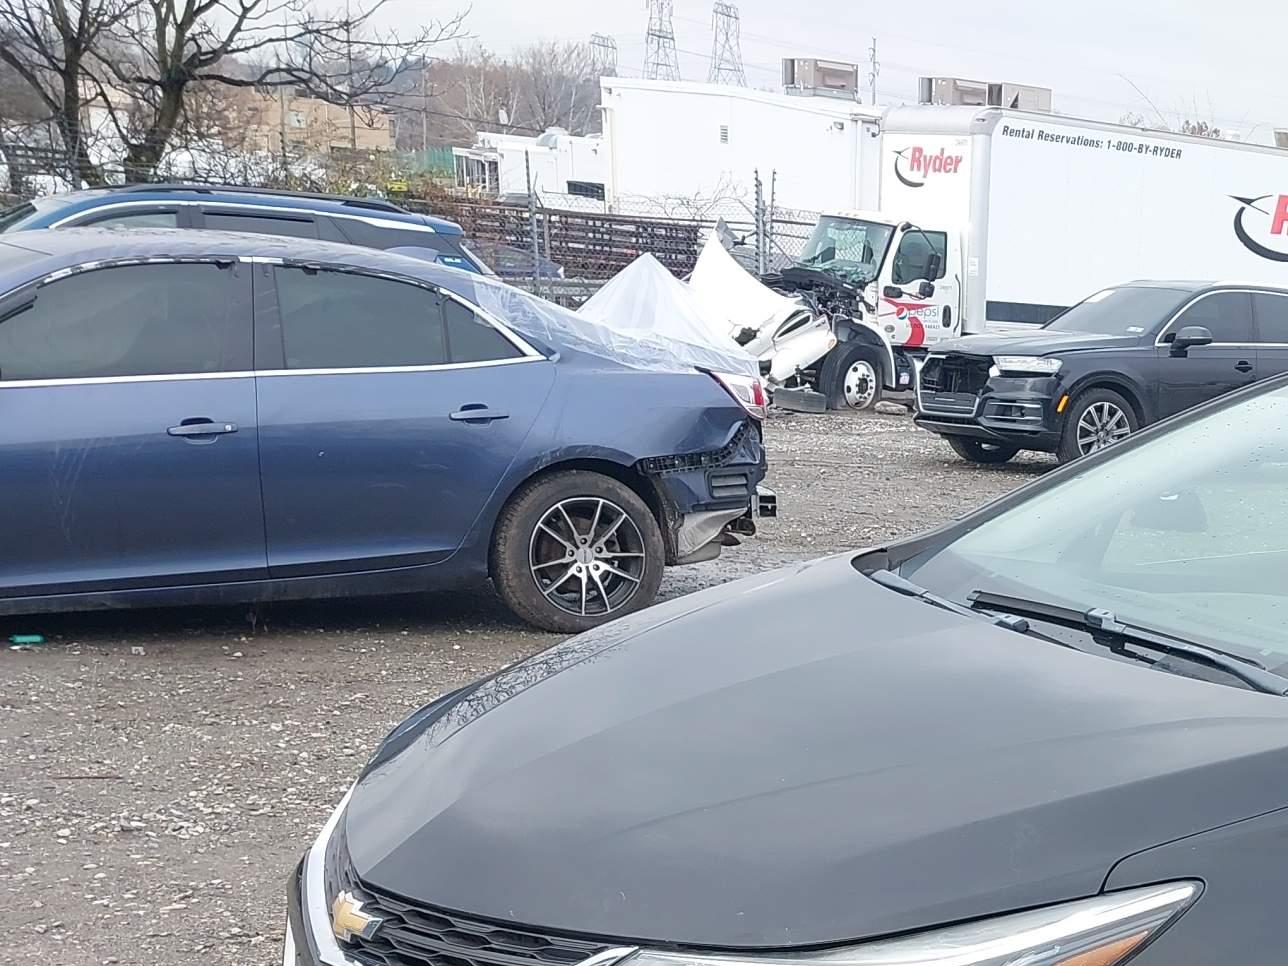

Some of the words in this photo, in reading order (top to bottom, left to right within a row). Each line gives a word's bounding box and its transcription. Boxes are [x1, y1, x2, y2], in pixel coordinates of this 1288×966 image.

[1002, 125, 1035, 140] Rental
[1037, 130, 1103, 149] Reservations:
[1107, 139, 1182, 160] 1-800-BY-RYDER
[910, 146, 963, 178] Ryder
[907, 306, 940, 320] pepsi
